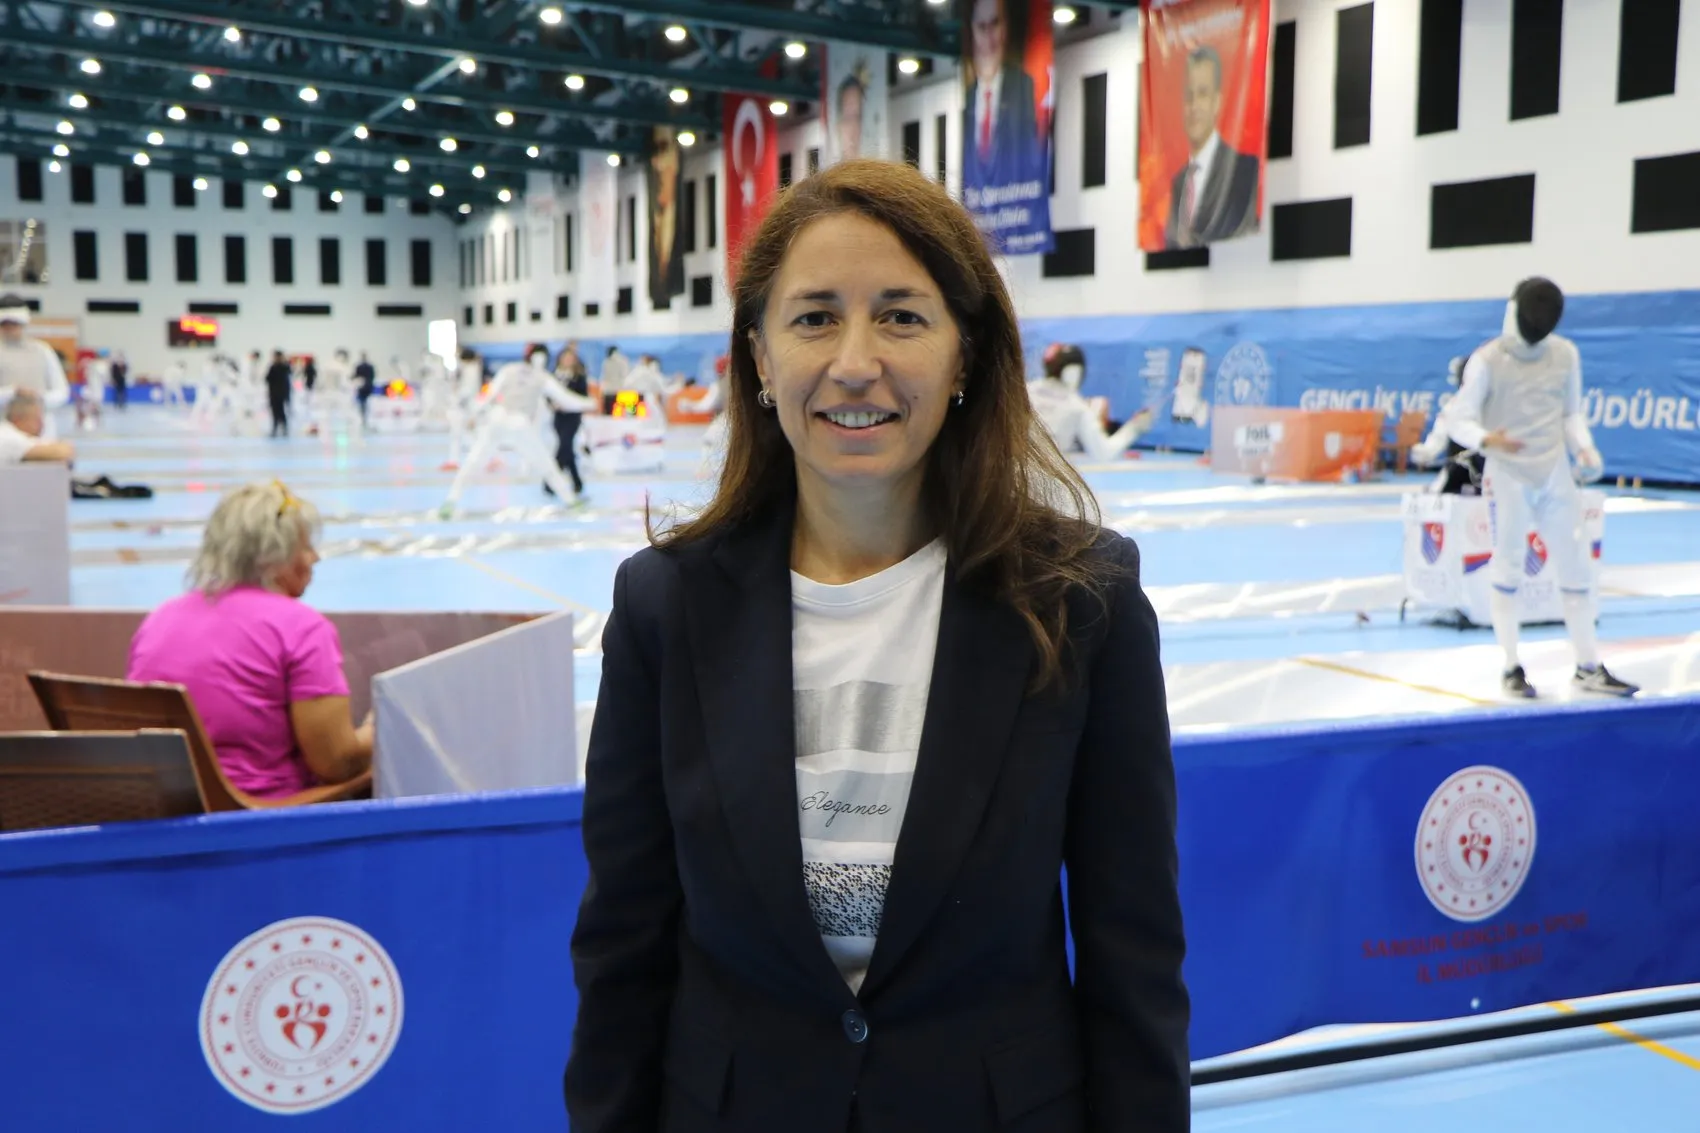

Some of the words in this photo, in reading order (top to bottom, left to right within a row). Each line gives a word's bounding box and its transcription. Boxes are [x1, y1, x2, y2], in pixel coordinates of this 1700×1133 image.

[1583, 388, 1700, 431] ÜDÜRL
[800, 790, 892, 828] Elegance
[1362, 934, 1446, 960] SAMSUN
